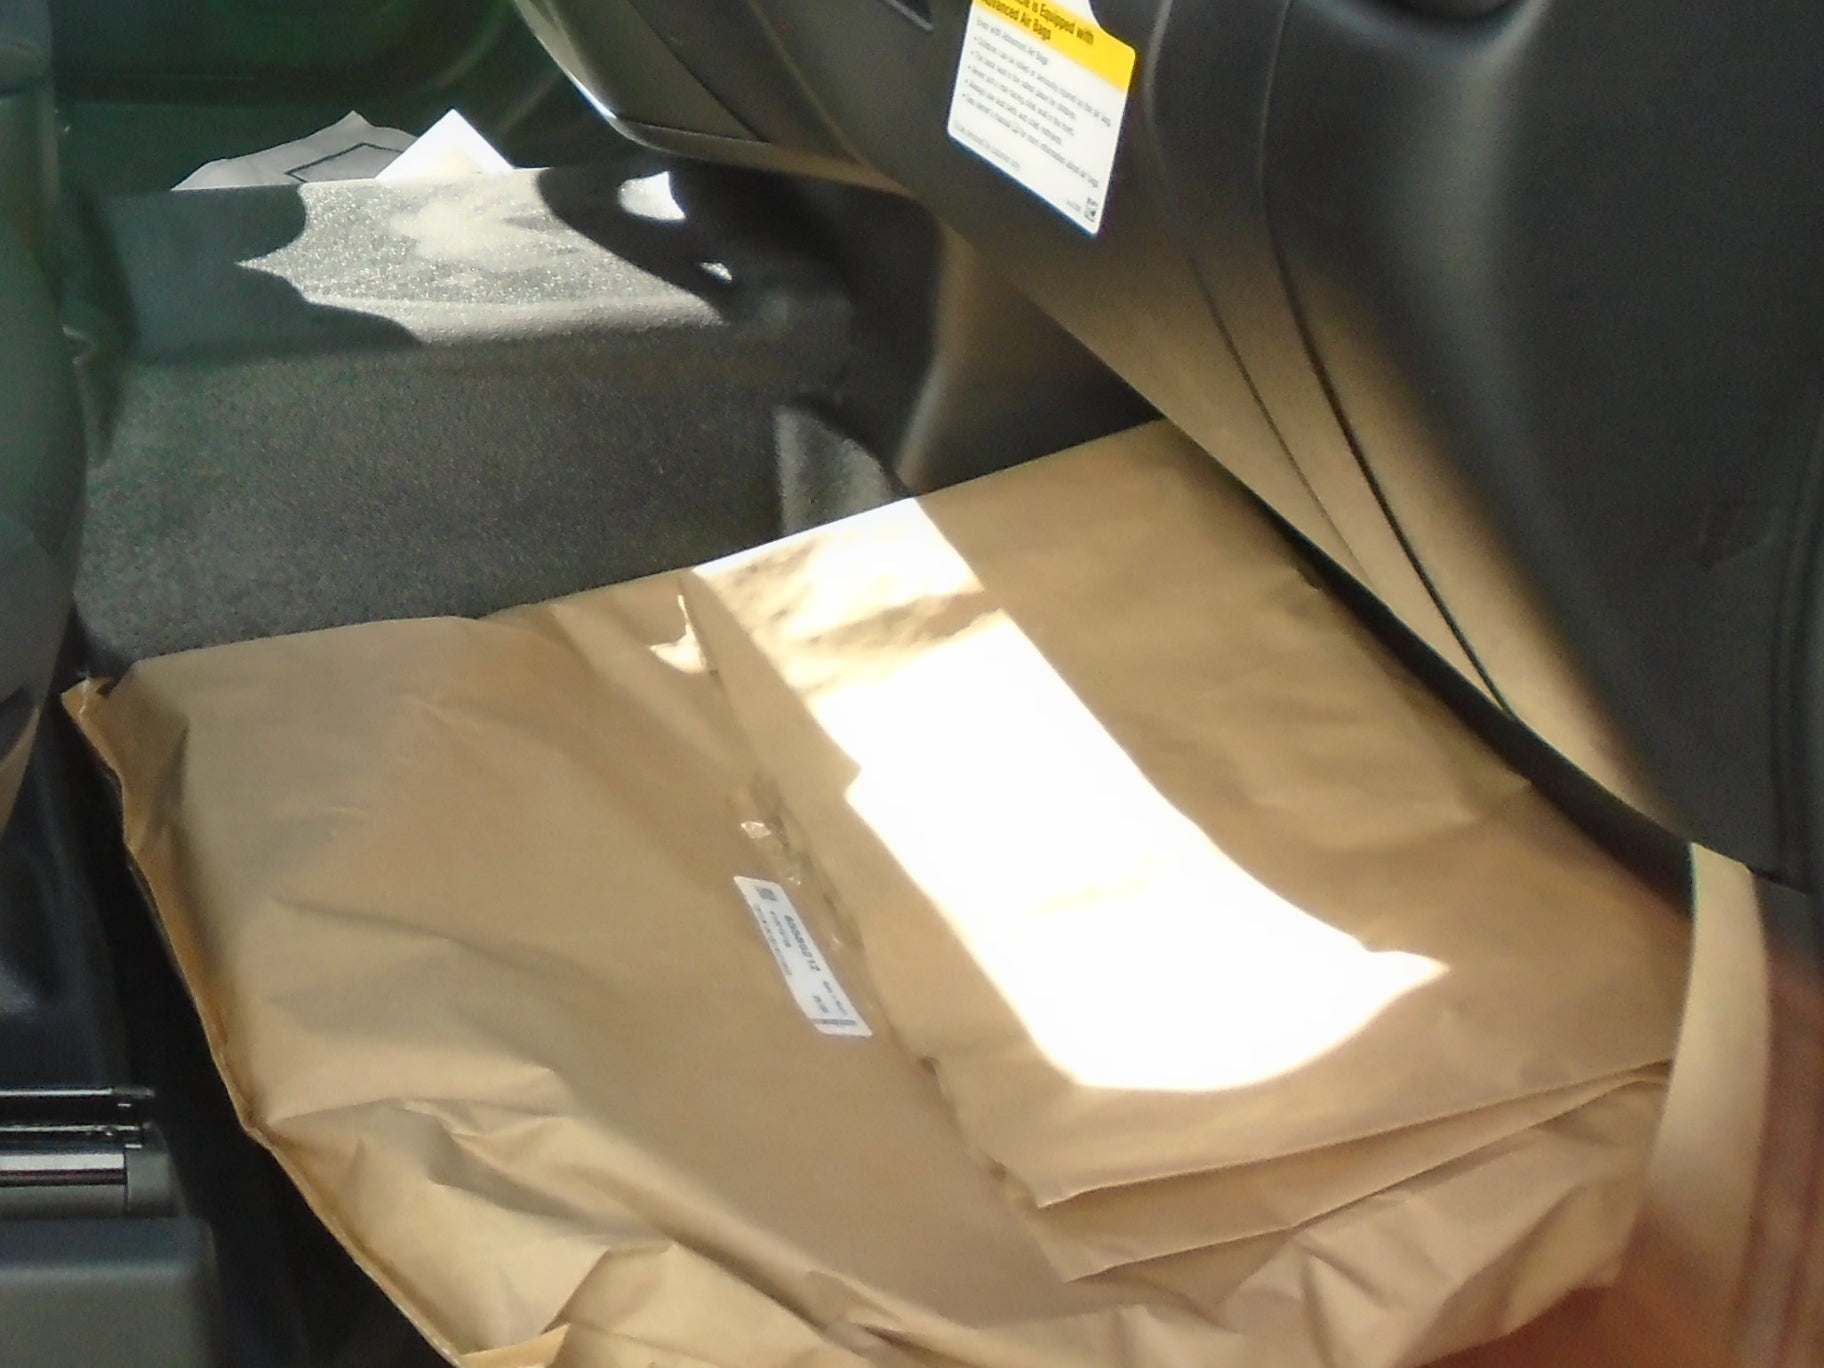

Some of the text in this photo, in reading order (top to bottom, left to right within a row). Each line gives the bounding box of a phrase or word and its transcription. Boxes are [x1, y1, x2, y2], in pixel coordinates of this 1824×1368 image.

[1020, 11, 1032, 27] Air
[1033, 18, 1051, 40] Bags
[1040, 3, 1075, 34] Equipped
[1076, 26, 1094, 45] with
